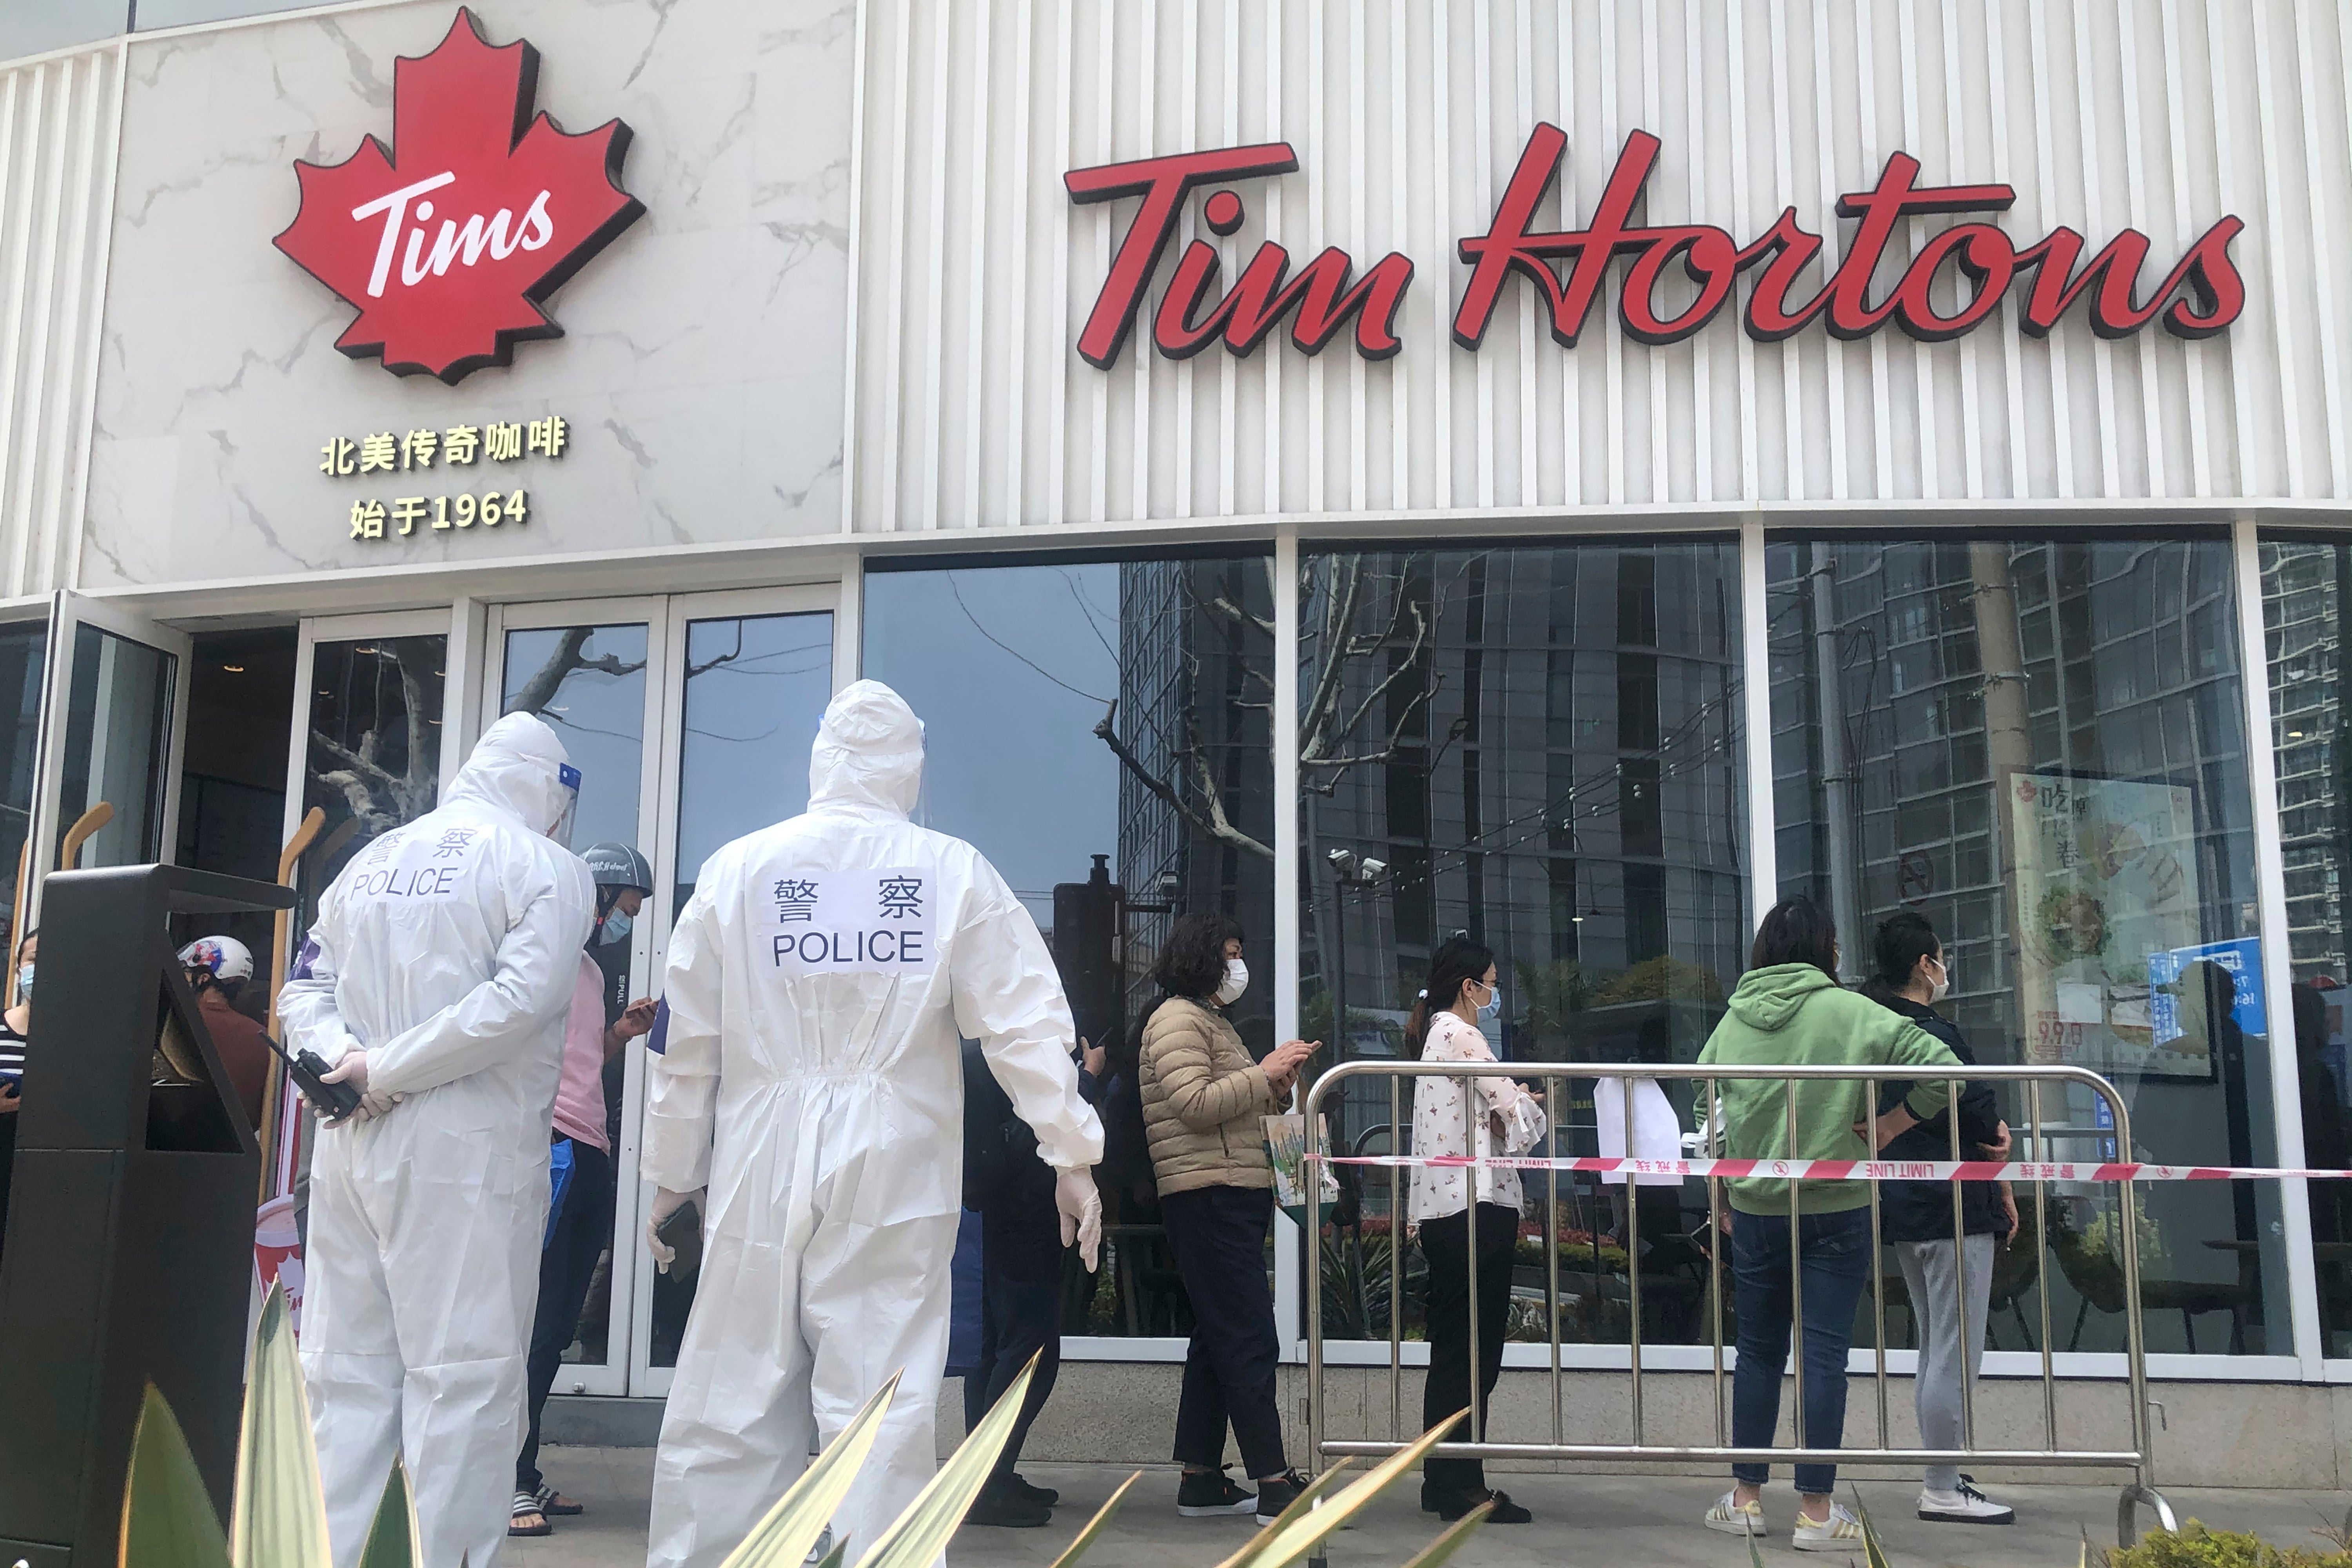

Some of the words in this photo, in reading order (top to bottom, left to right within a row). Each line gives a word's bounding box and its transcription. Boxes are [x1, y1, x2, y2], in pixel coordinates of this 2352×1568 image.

[352, 171, 554, 298] Tims
[1063, 141, 1414, 372] Tim
[1452, 121, 2246, 350] Hortons
[319, 416, 568, 477] 北美传奇咖啡
[349, 489, 528, 541] 始于1964
[368, 826, 479, 865] 警察
[350, 867, 458, 901] POLICE
[774, 875, 923, 924] 警察
[773, 930, 924, 967] POLICE
[1635, 1160, 1691, 1175] 警戒线
[1866, 1163, 1895, 1177] LINE
[1899, 1163, 1935, 1178] LIMIT
[2020, 1164, 2075, 1179] 警戒线
